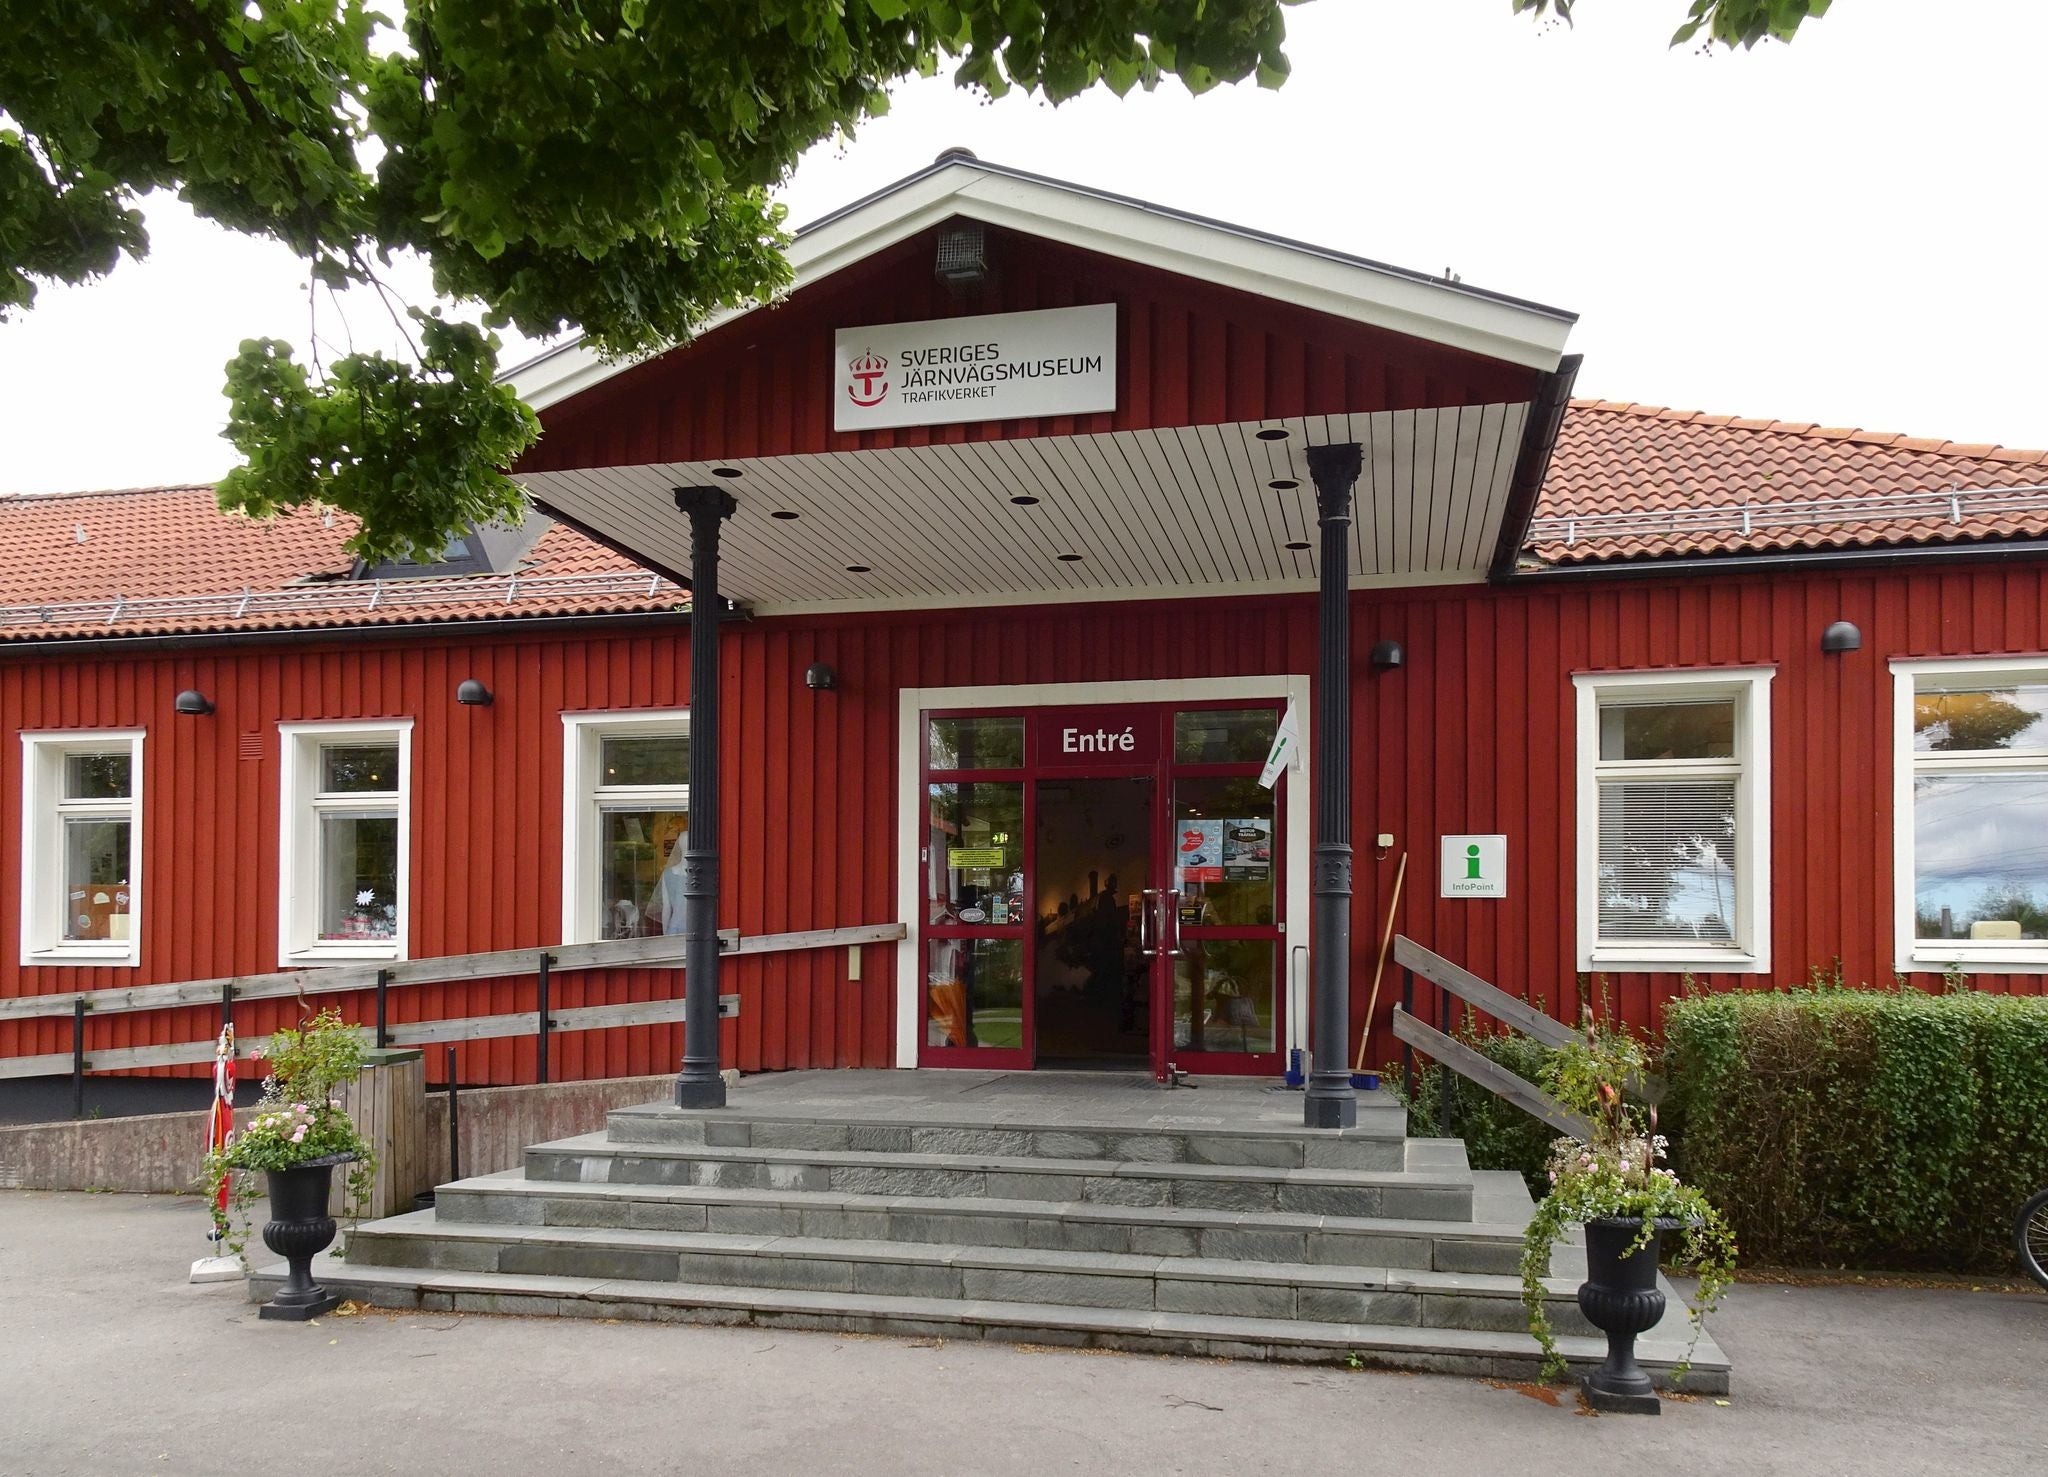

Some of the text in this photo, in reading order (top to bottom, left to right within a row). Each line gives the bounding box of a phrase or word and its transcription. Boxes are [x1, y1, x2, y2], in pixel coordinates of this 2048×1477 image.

[900, 343, 1000, 368] SVERIGES
[901, 355, 1103, 389] JÄRNVÄGSMUSEUM
[901, 385, 997, 404] TRAFIKVERKET
[1062, 726, 1136, 753] Entré
[1452, 883, 1494, 891] InfoPoint
